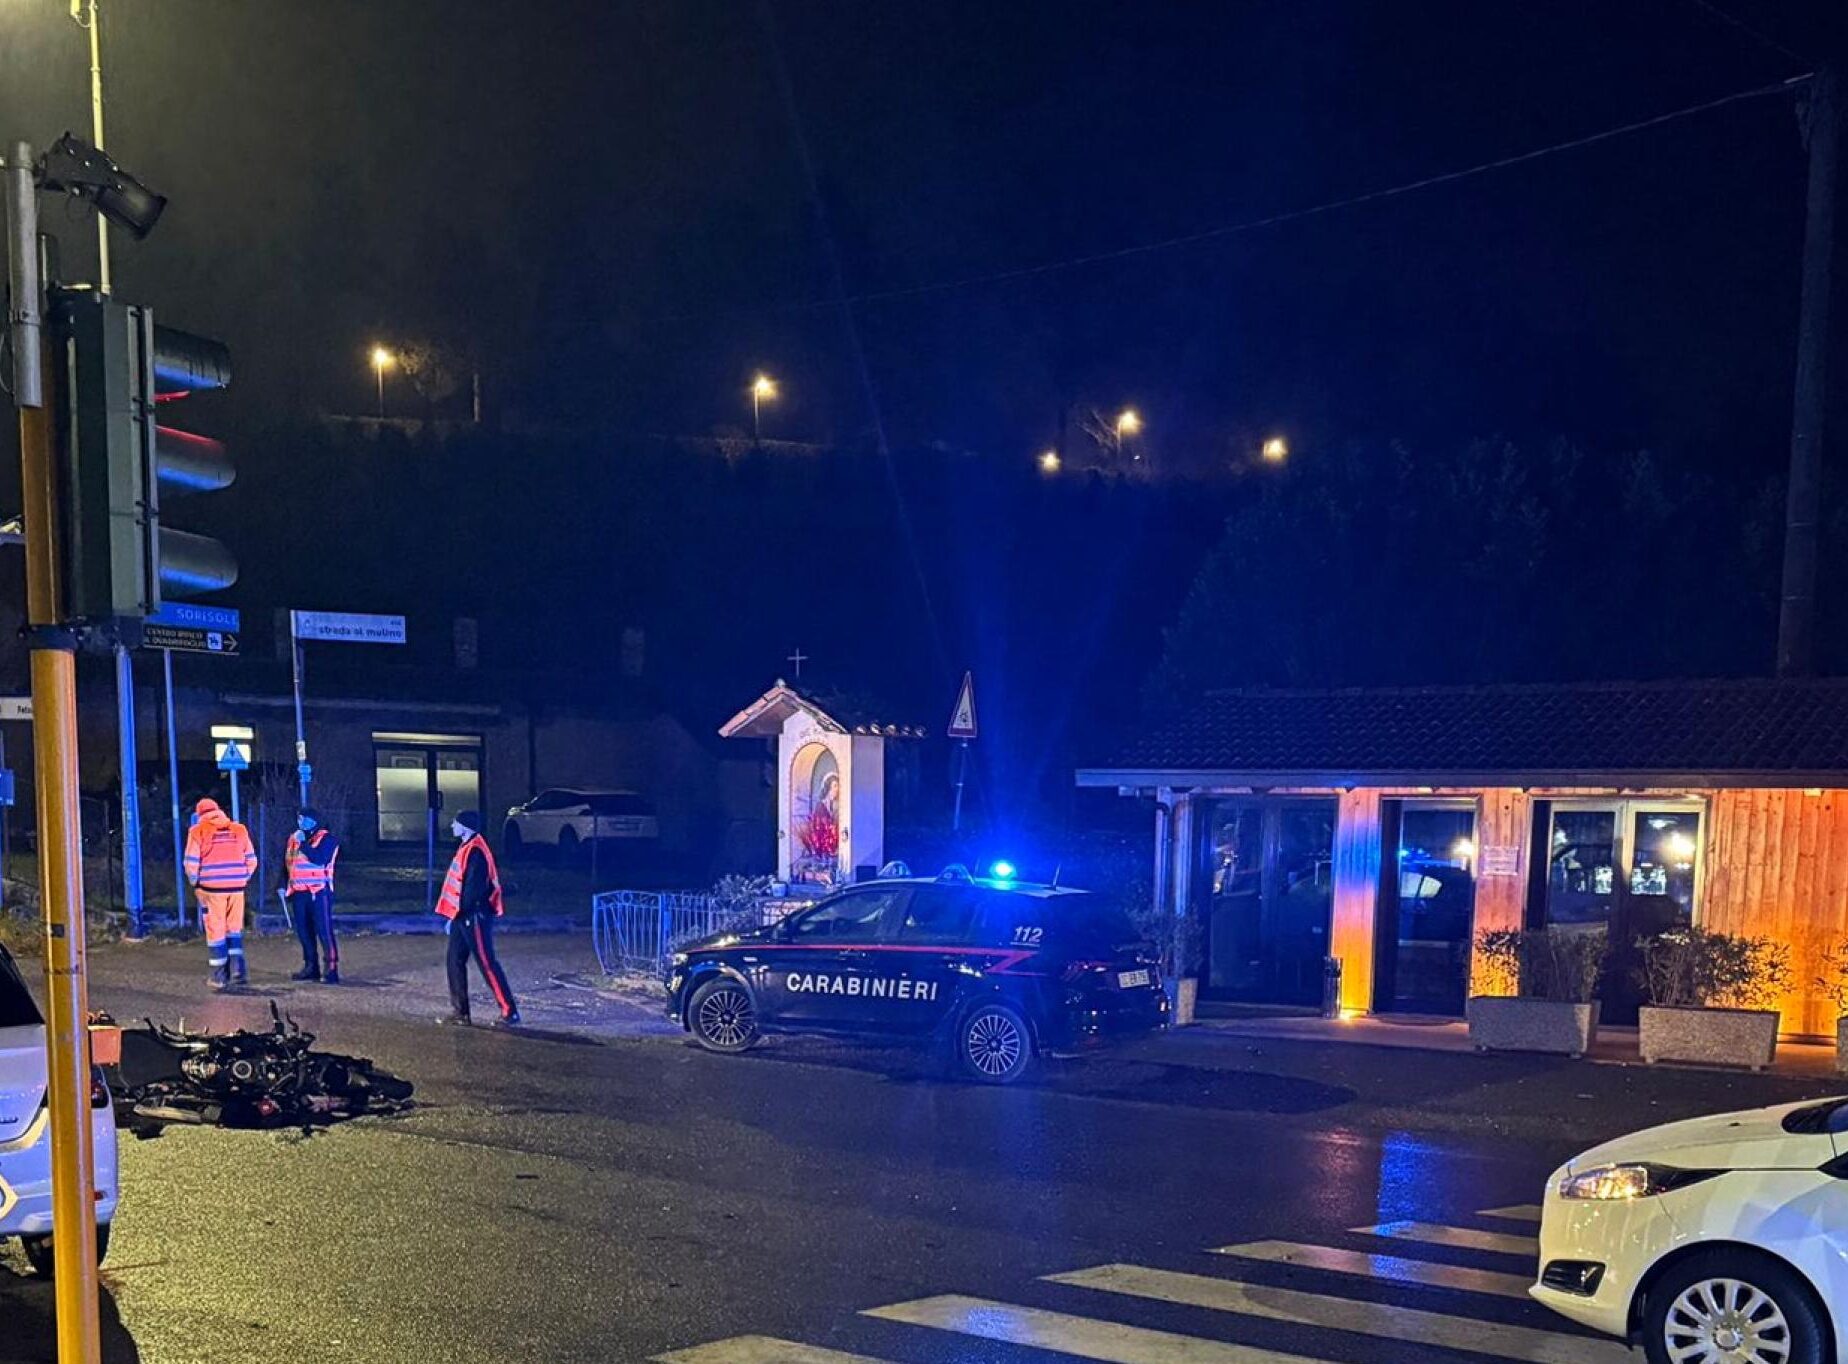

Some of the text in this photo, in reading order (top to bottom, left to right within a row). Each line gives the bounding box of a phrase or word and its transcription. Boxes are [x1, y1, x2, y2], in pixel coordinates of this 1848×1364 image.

[320, 626, 351, 636] strada
[366, 628, 402, 638] mulino
[1014, 926, 1043, 942] 112
[786, 972, 938, 1001] CARABINIERI
